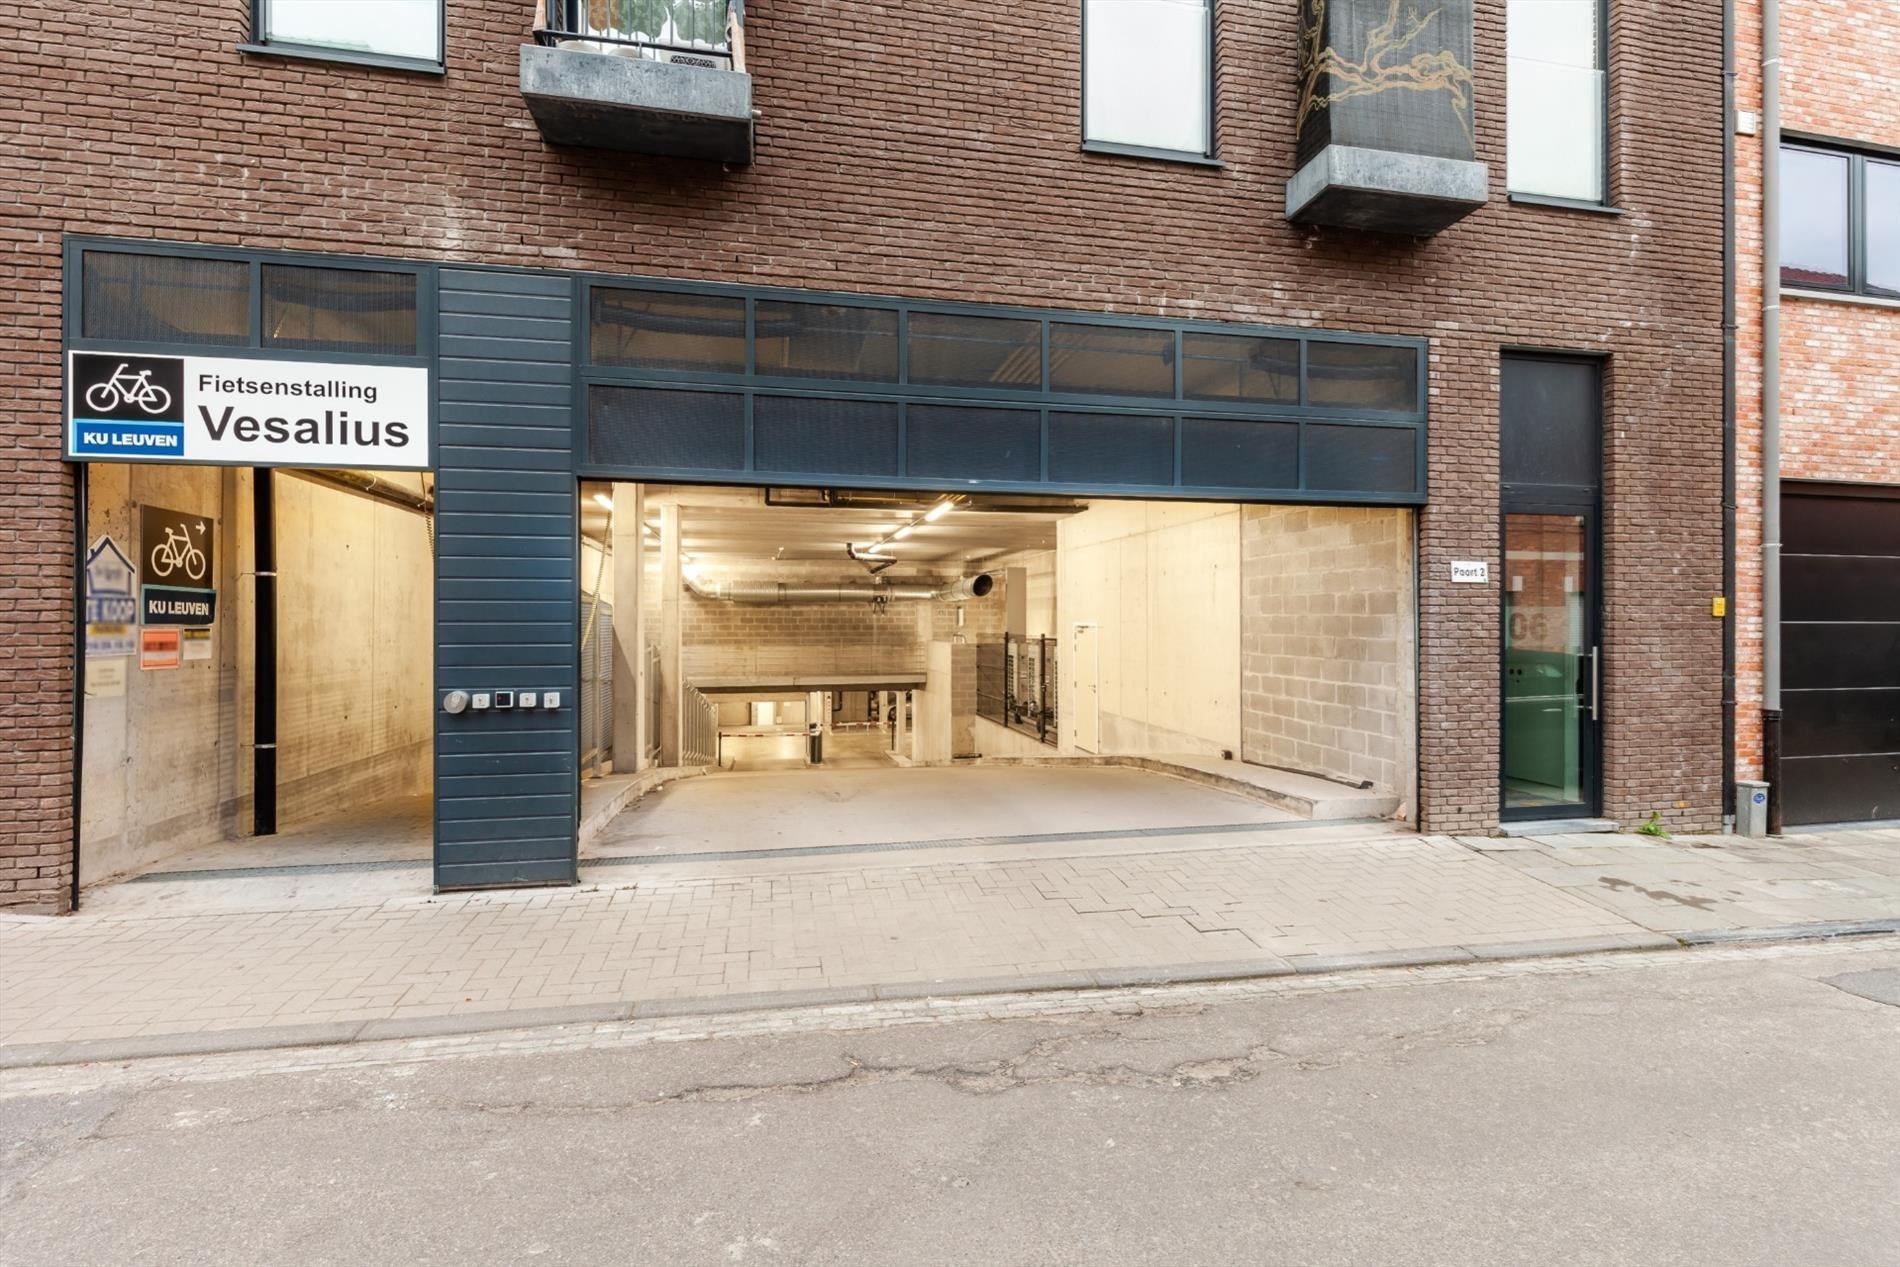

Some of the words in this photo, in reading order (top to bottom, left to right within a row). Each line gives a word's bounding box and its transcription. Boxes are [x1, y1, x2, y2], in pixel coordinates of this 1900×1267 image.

[198, 374, 377, 404] Fietsenstalling
[198, 404, 410, 448] Vesalius
[83, 432, 109, 445] KU
[111, 433, 178, 447] LEUVEN
[1479, 567, 1486, 577] 2
[149, 600, 166, 614] KU
[168, 601, 209, 616] LEUVEN
